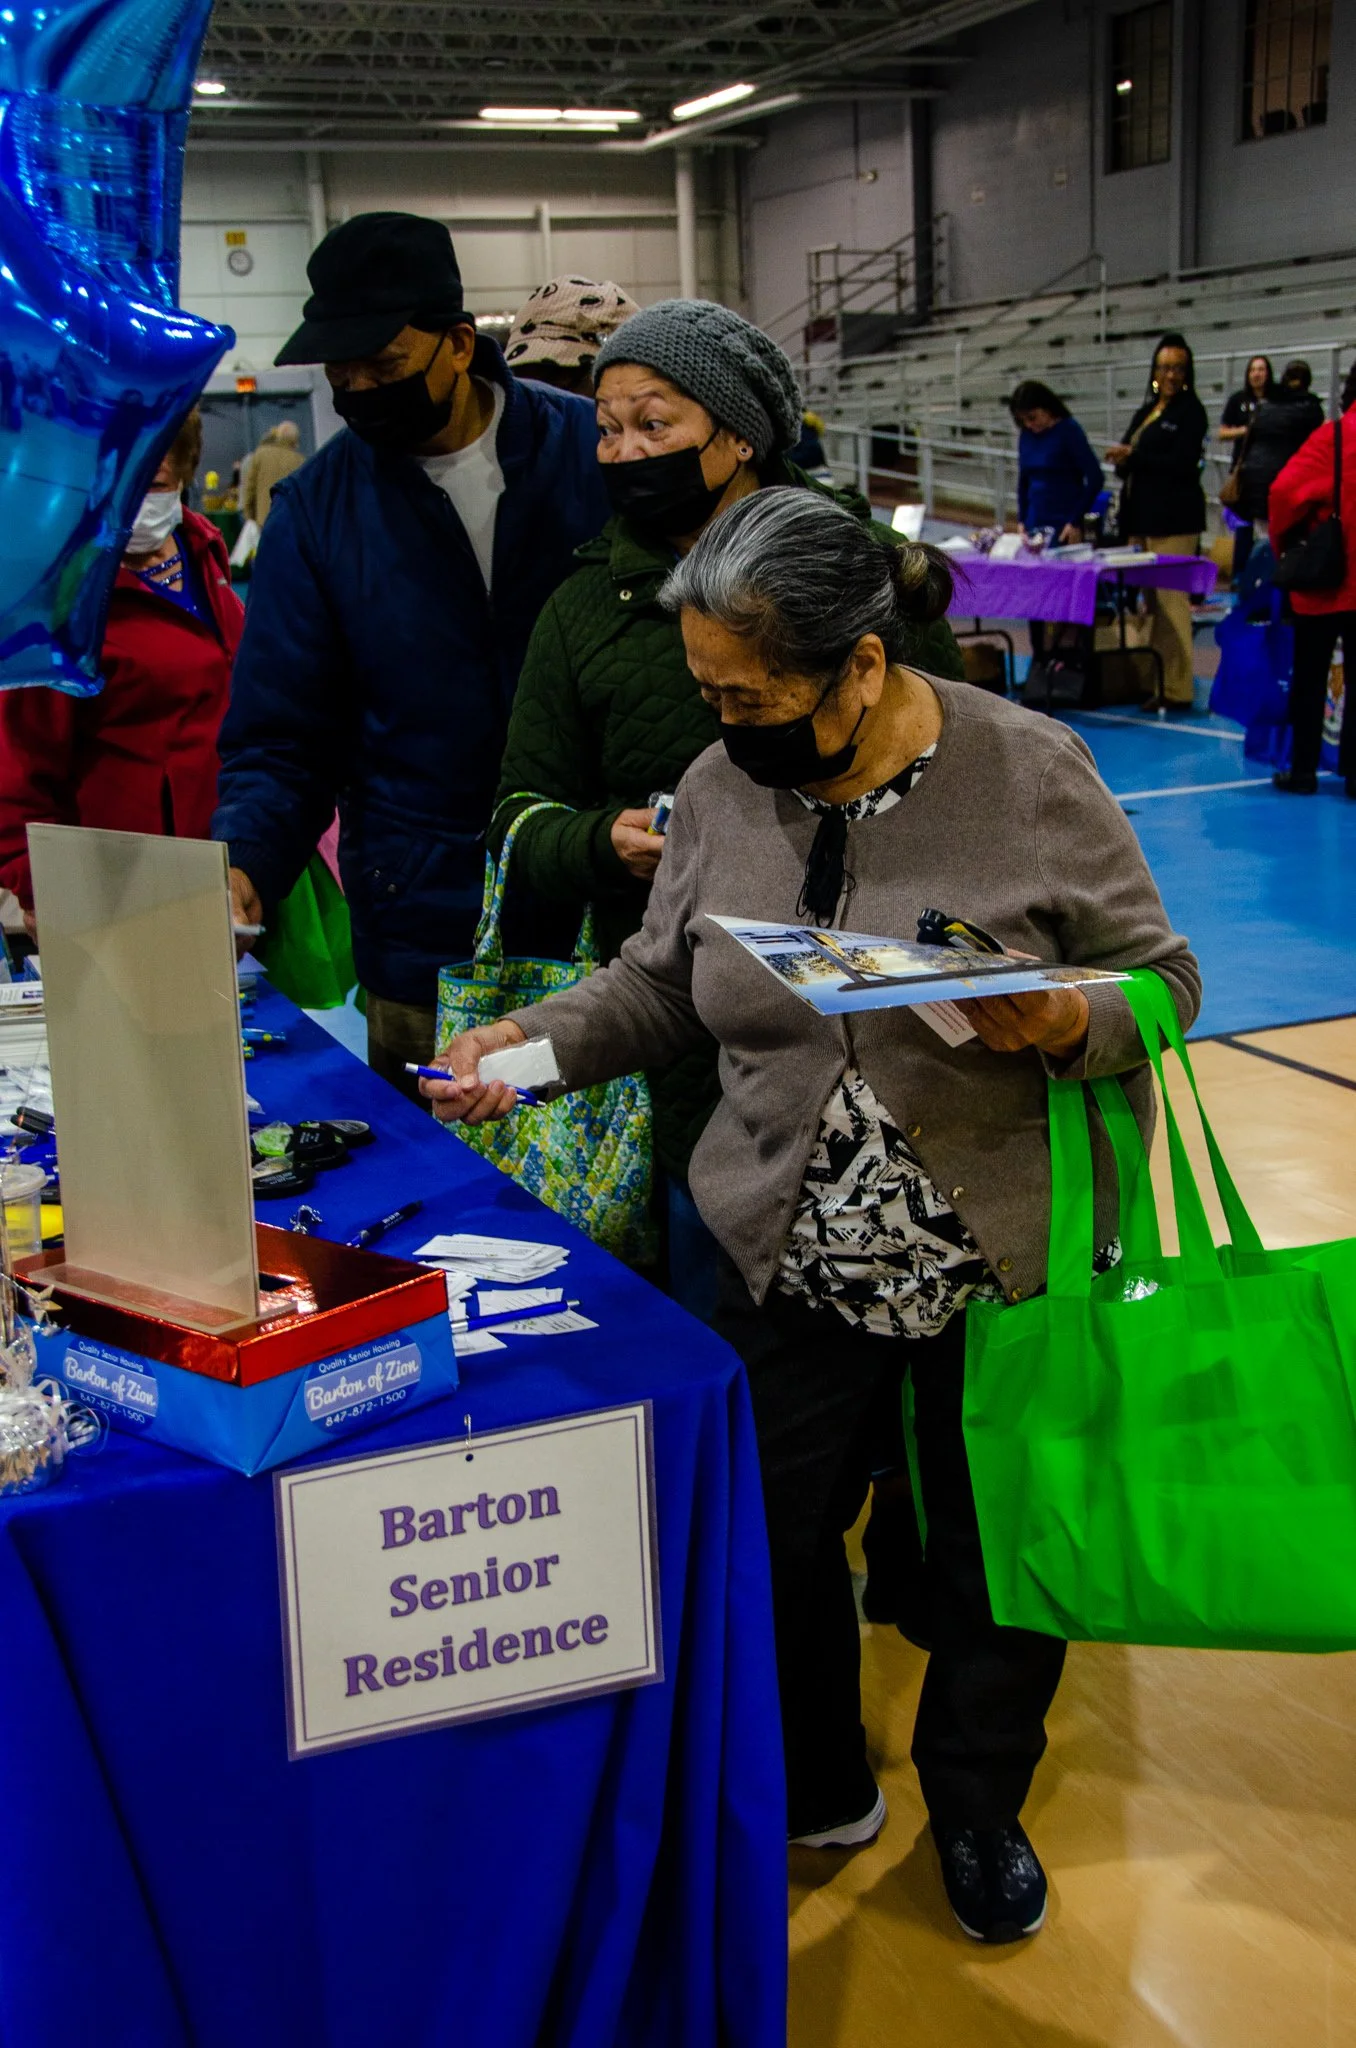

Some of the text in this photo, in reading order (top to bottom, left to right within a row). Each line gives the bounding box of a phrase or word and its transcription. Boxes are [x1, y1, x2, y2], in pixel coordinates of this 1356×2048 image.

[64, 1356, 156, 1407] Barton of Zion
[78, 1340, 144, 1373] Quality Senior Housing
[318, 1339, 401, 1374] Quality Senior Housing
[306, 1359, 420, 1410] Barton of Zion
[325, 1389, 407, 1427] 847-872-1500
[379, 1484, 562, 1551] Barton
[388, 1553, 560, 1619] Senior
[342, 1611, 609, 1699] Residence
